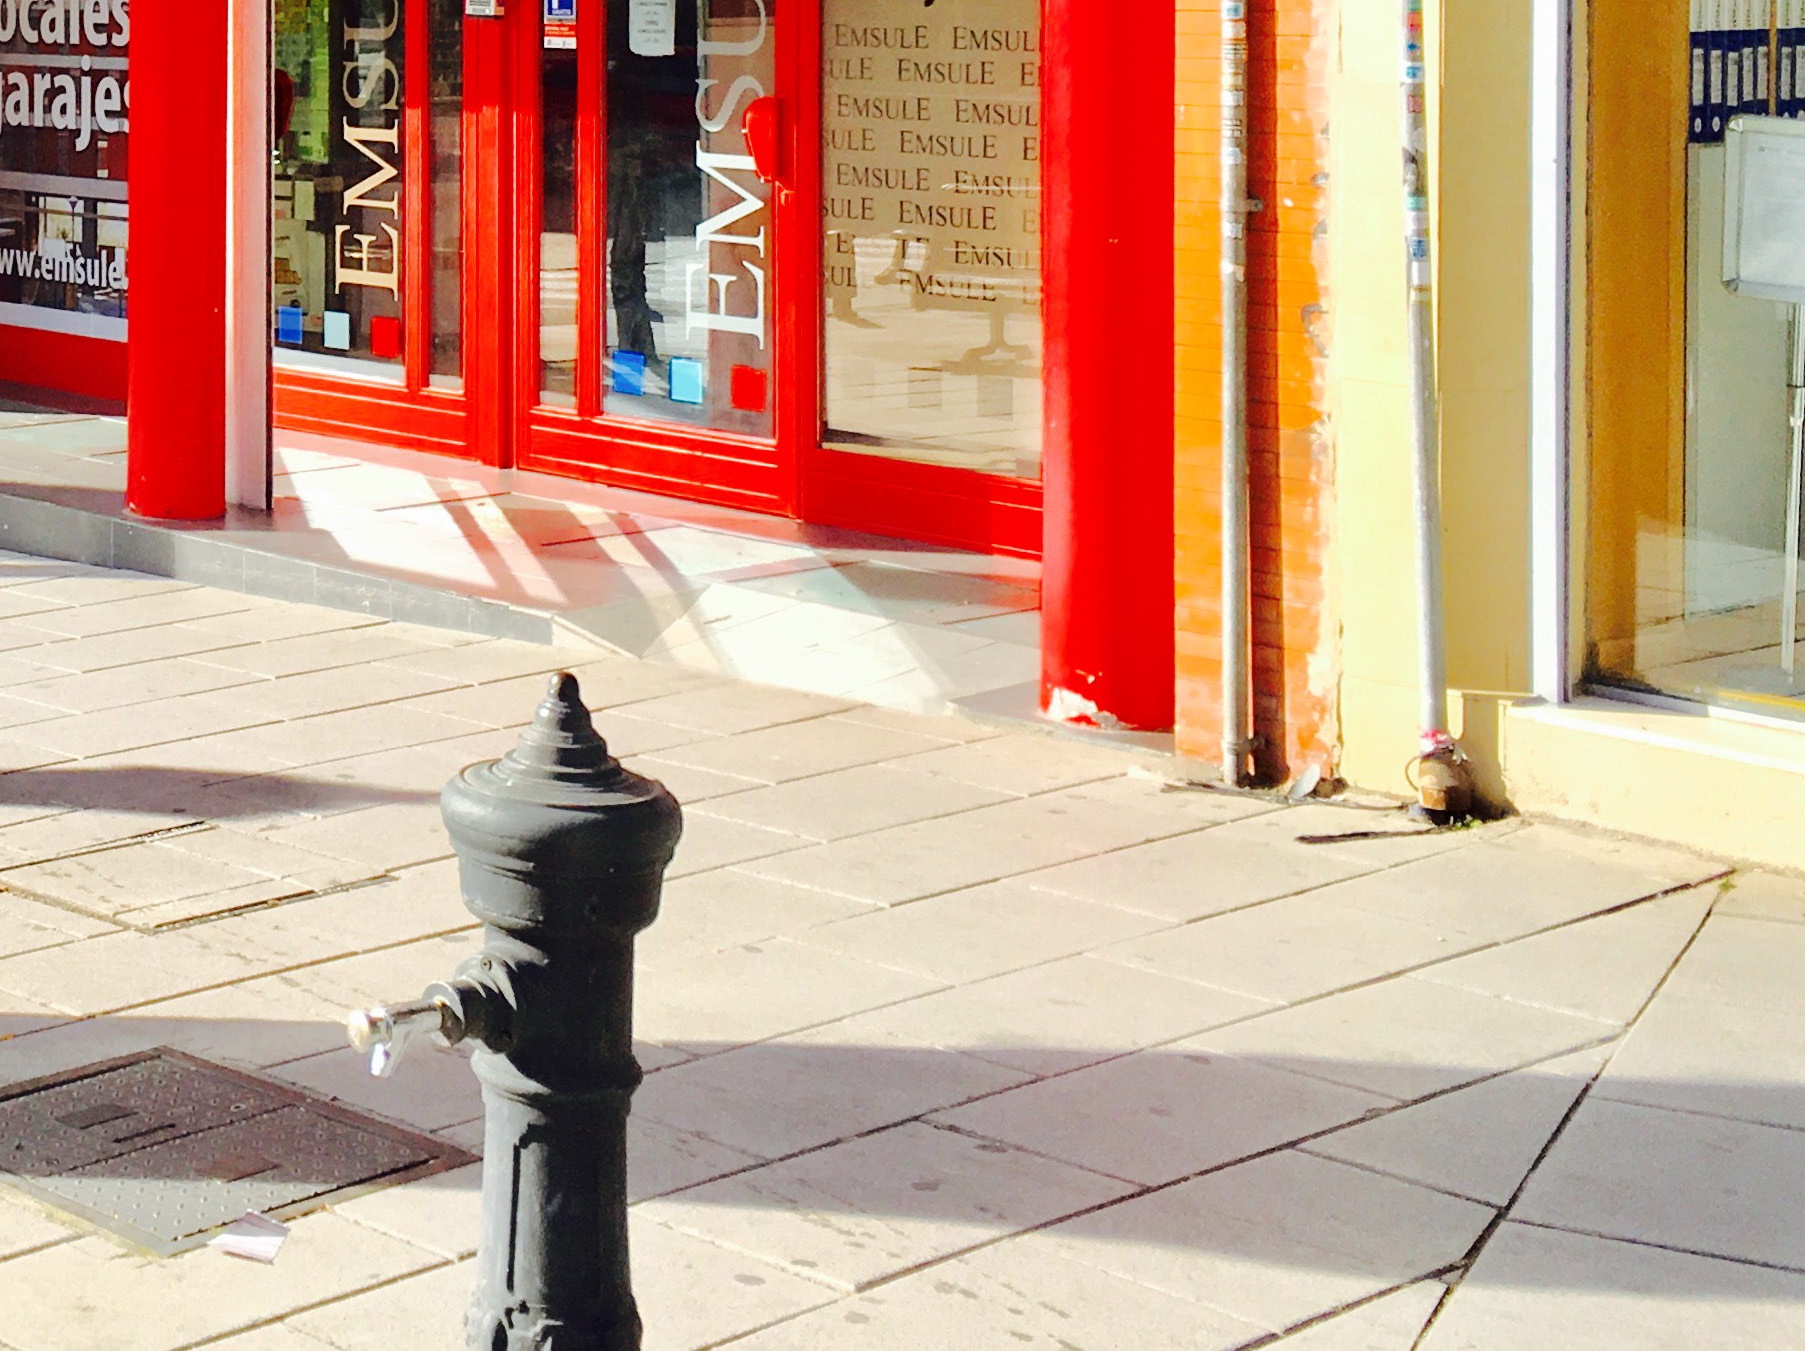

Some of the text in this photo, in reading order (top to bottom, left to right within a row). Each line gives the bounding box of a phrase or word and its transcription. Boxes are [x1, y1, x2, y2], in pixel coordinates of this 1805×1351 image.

[835, 24, 1041, 52] EMSULE EMSUL
[898, 58, 994, 85] EMSULE
[837, 94, 1039, 127] EMSULE EMSUL
[900, 130, 998, 159] EMSULE
[836, 163, 1039, 198] EMSULE EMSUL
[898, 200, 997, 231] EMSULE
[953, 240, 1039, 270] EMSUL
